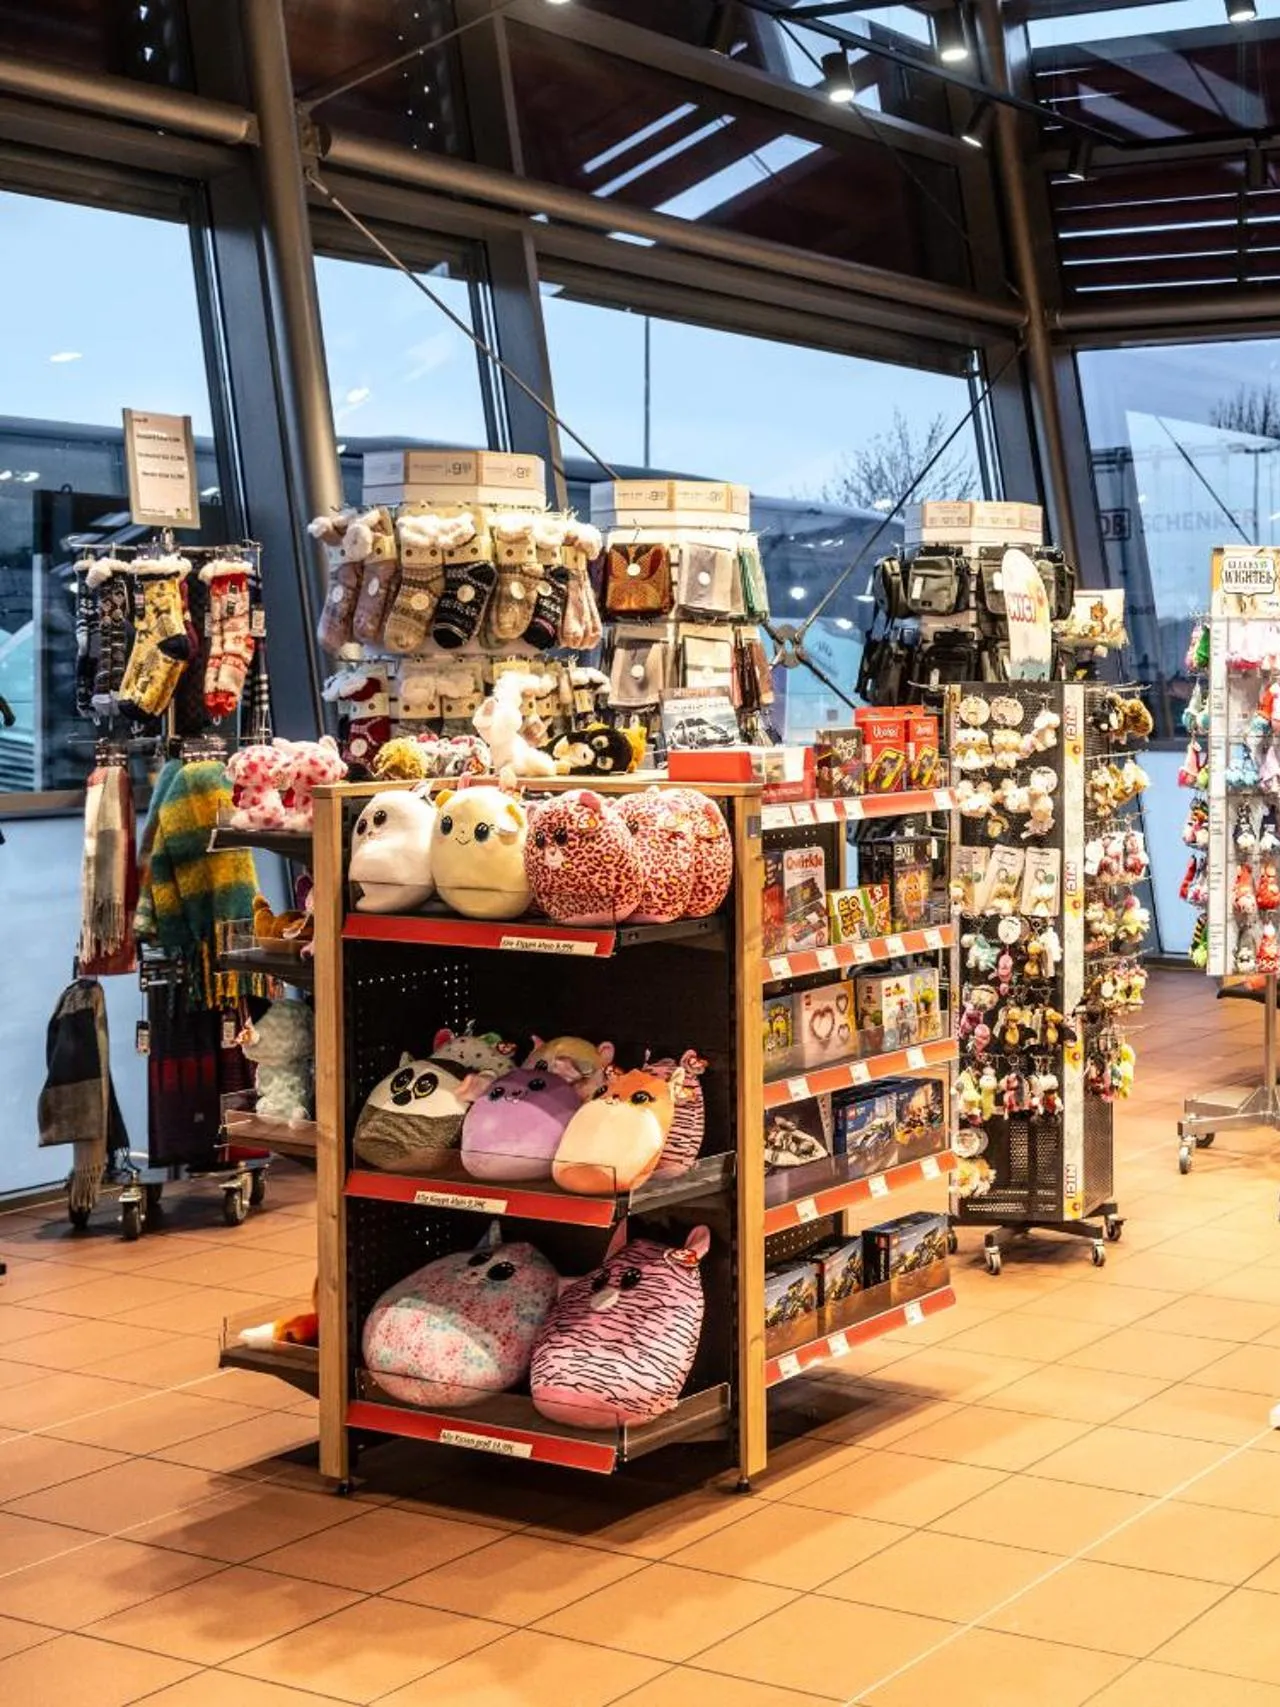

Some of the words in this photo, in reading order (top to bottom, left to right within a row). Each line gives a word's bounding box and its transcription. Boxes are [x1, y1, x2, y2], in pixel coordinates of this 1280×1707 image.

[1064, 706, 1077, 741] NICI
[1064, 861, 1077, 896] NICI
[1064, 1164, 1077, 1200] NICI
